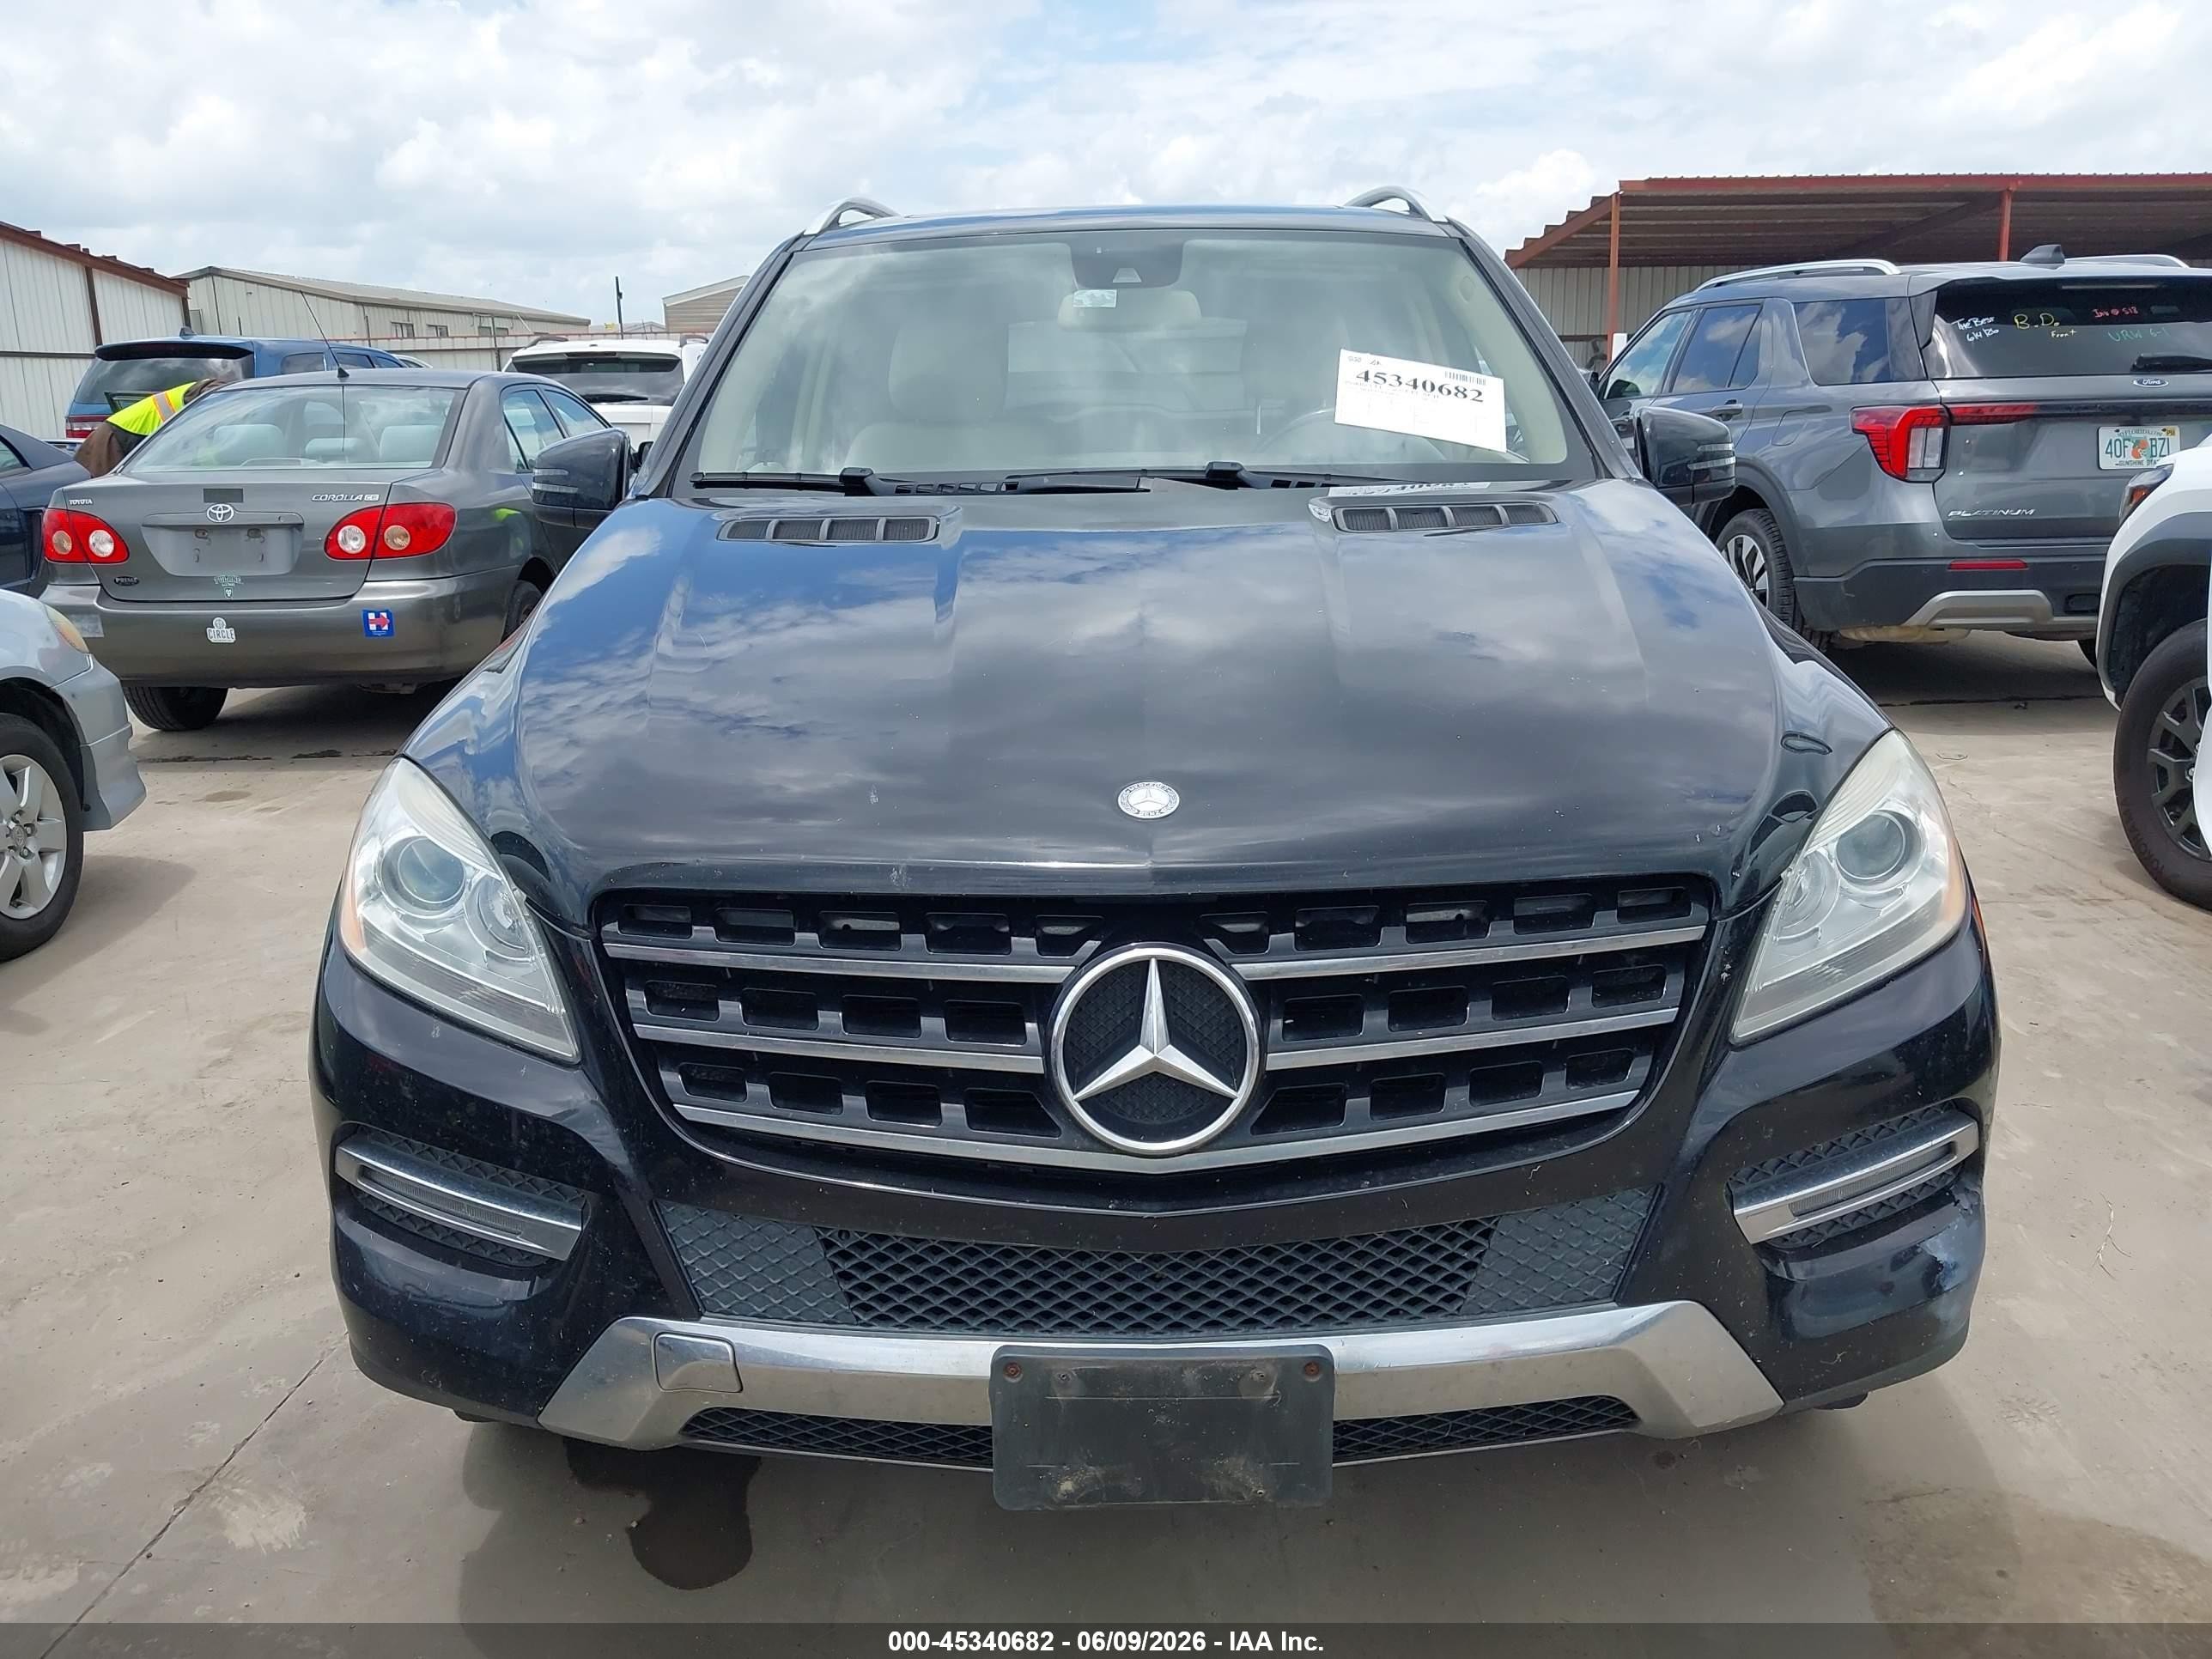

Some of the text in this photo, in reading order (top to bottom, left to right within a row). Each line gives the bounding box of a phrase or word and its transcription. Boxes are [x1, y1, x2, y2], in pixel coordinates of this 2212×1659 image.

[1356, 369, 1485, 403] 45340682
[312, 494, 364, 502] COROLLA
[1948, 508, 2036, 518] PLATINUM
[208, 628, 235, 640] CIRCLE
